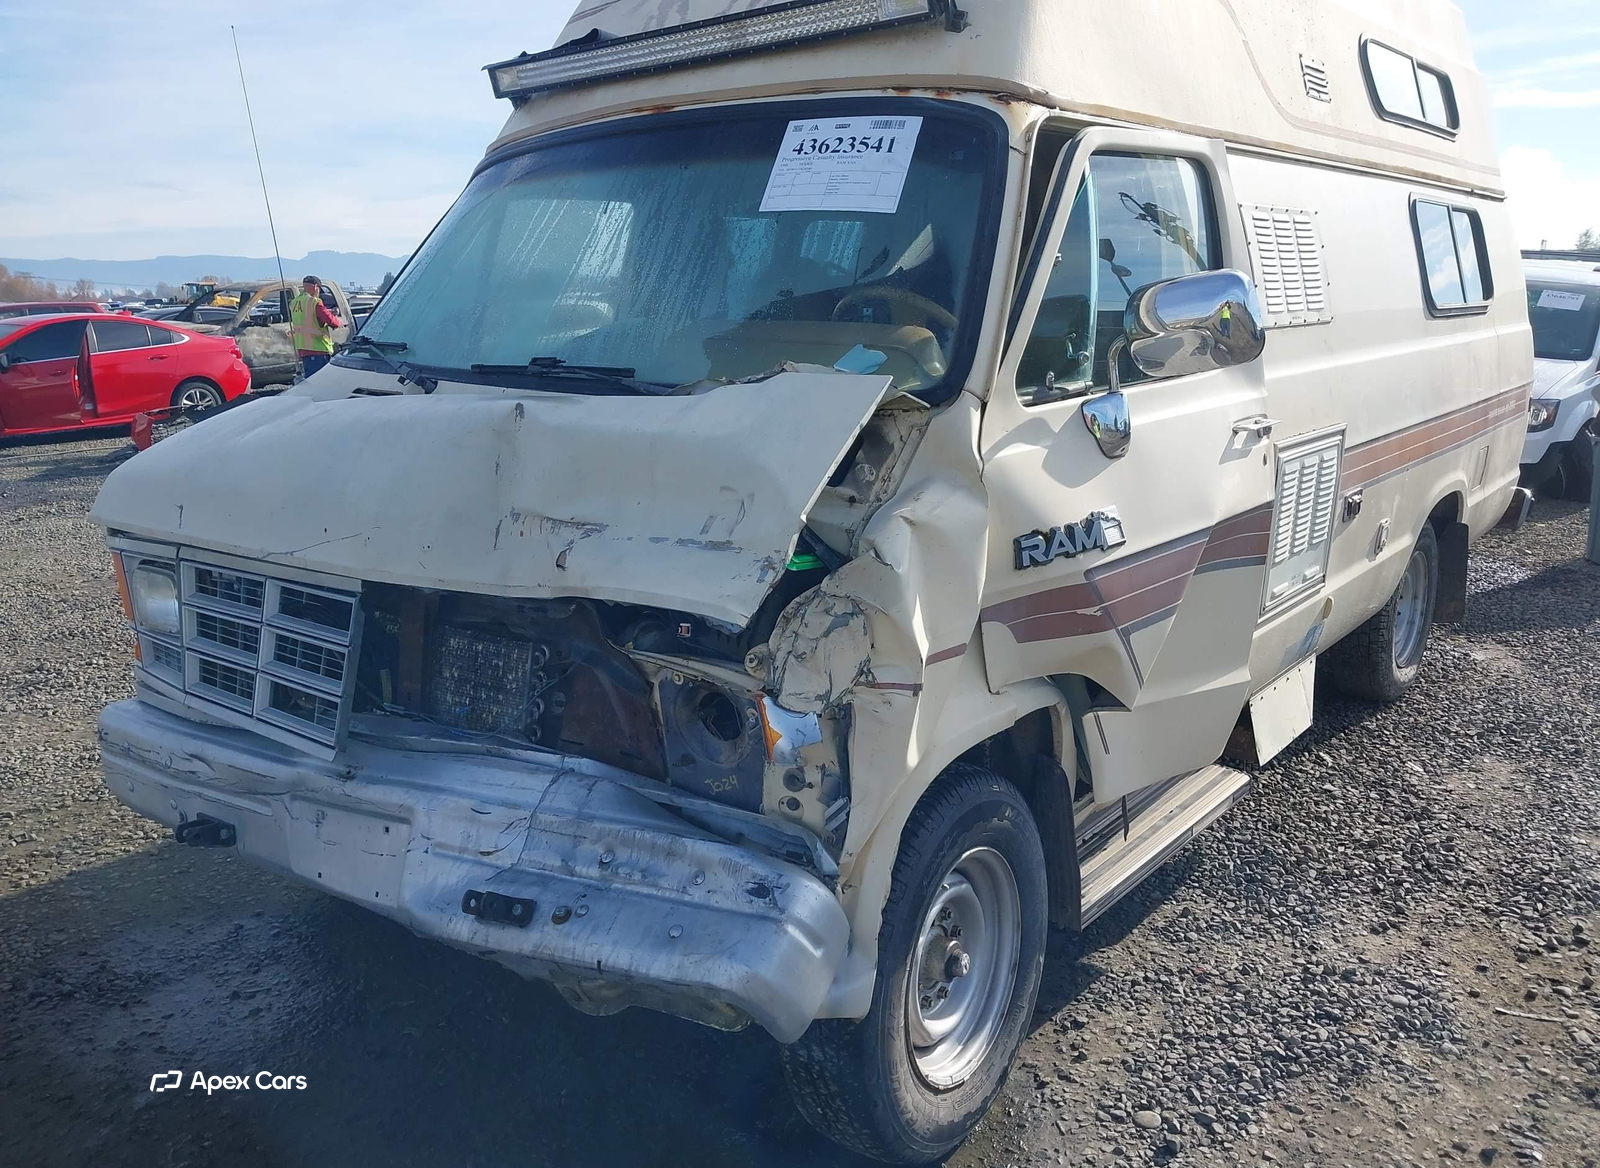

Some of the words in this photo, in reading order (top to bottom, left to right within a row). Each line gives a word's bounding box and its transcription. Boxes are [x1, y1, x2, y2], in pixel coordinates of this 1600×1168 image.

[792, 136, 897, 155] 43623541
[812, 154, 835, 162] Casualty
[1013, 511, 1105, 570] RAM
